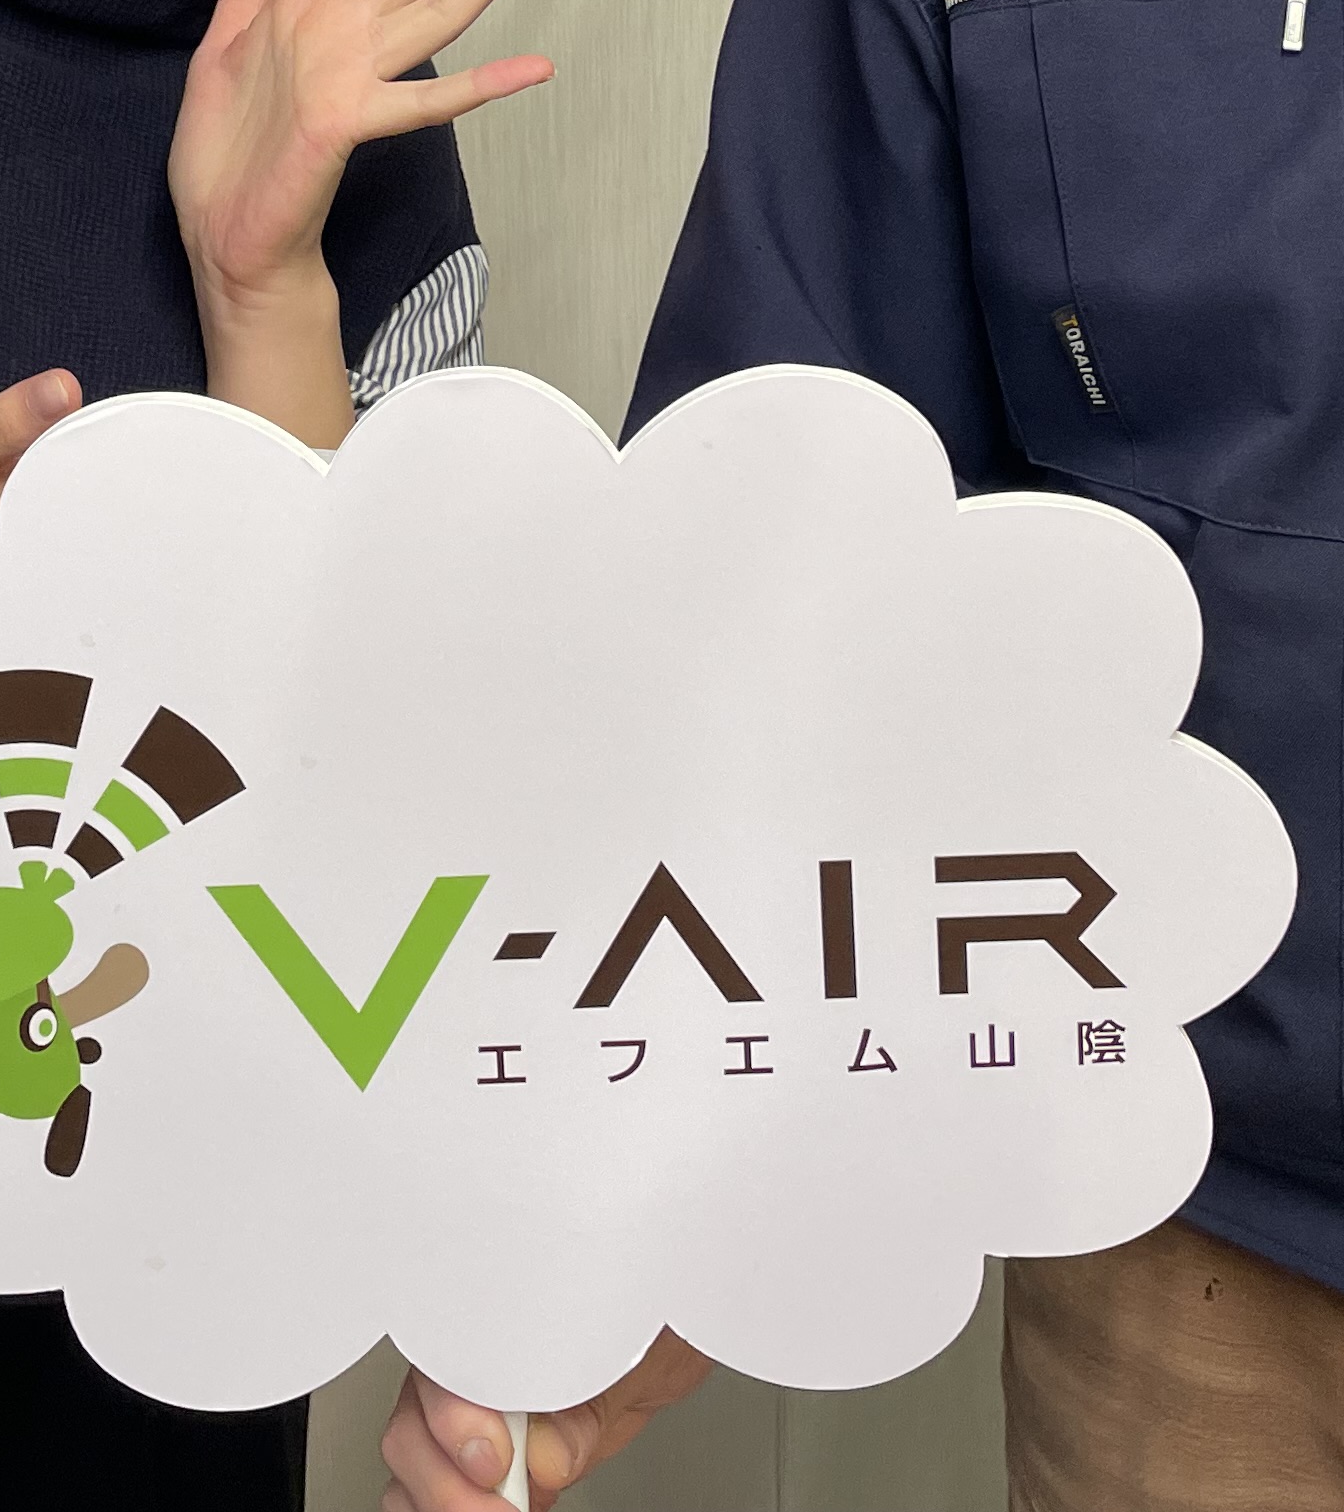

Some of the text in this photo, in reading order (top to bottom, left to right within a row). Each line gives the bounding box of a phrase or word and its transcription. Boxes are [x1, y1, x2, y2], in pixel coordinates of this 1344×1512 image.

[1061, 314, 1106, 405] TORAICHI
[205, 850, 1129, 1094] V-AIR
[476, 1021, 1129, 1087] エフエム山陰
